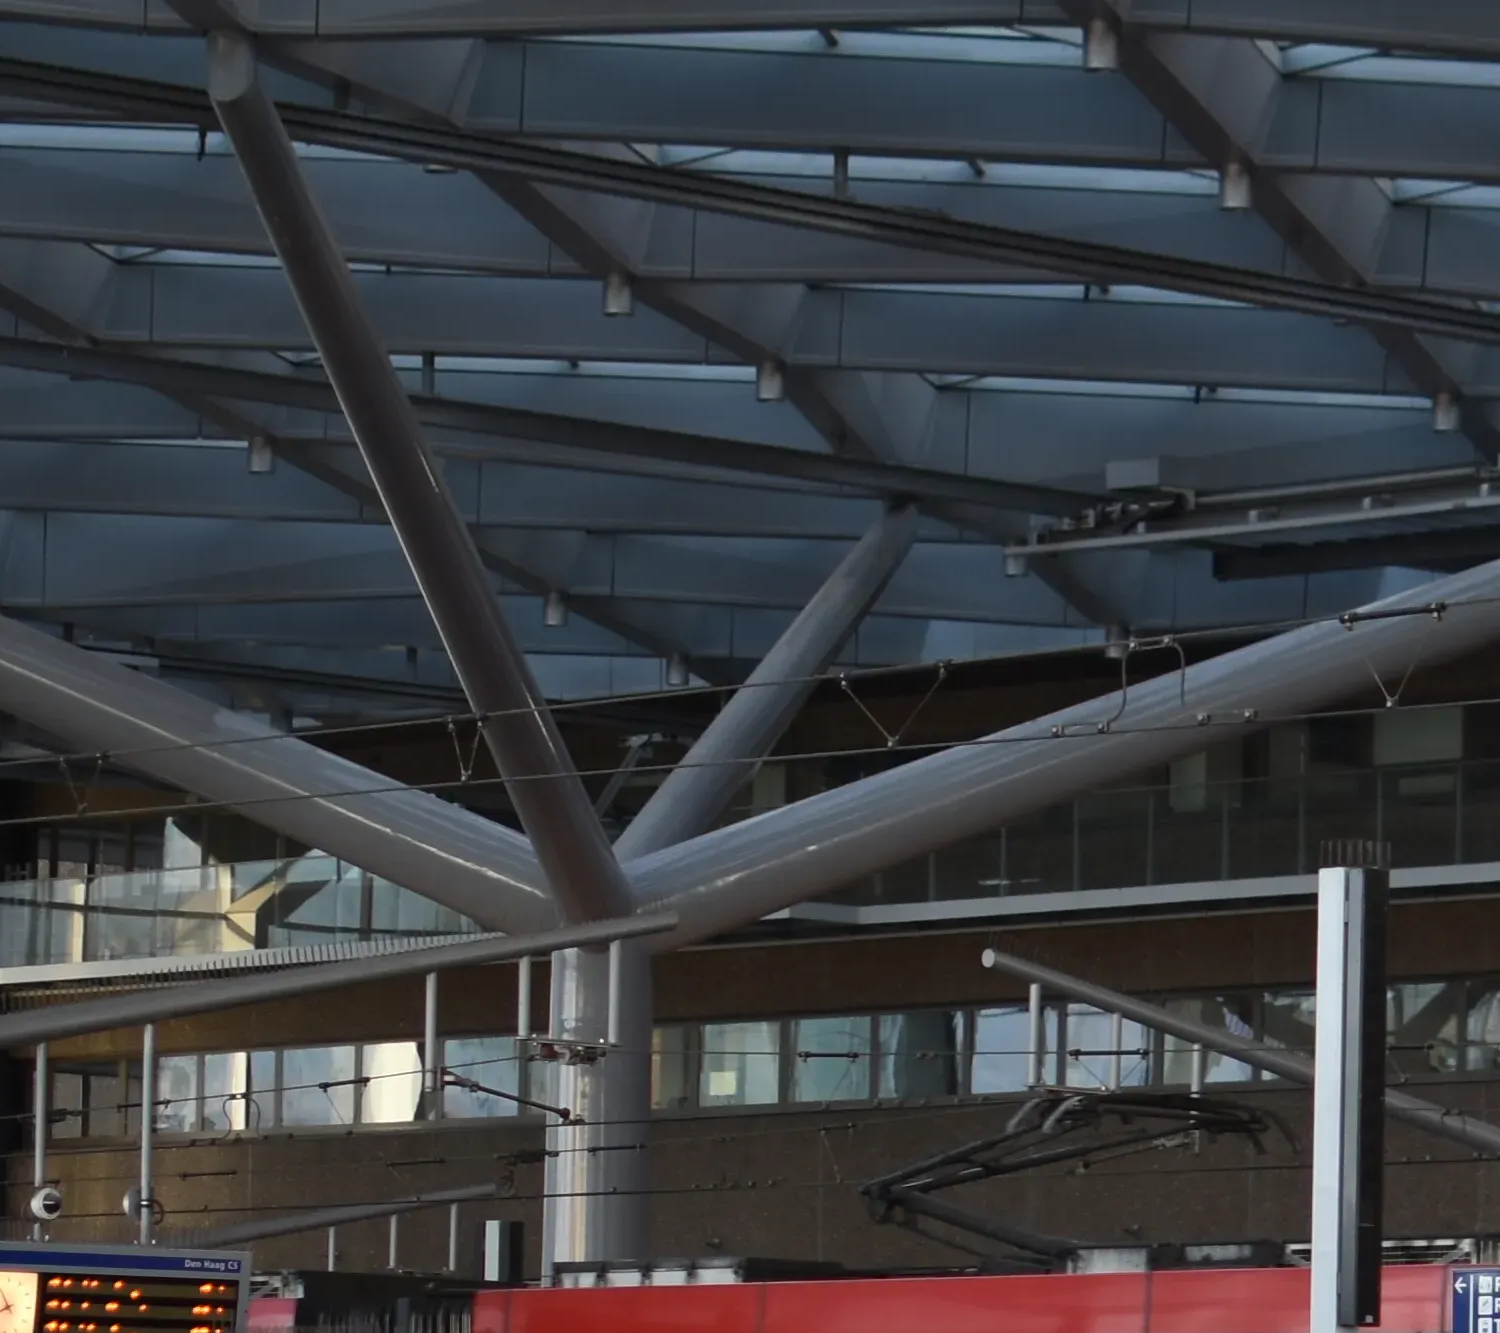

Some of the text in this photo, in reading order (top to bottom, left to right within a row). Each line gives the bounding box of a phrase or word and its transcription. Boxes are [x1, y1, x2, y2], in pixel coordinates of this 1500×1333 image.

[184, 1259, 239, 1271] Den Haag CS
